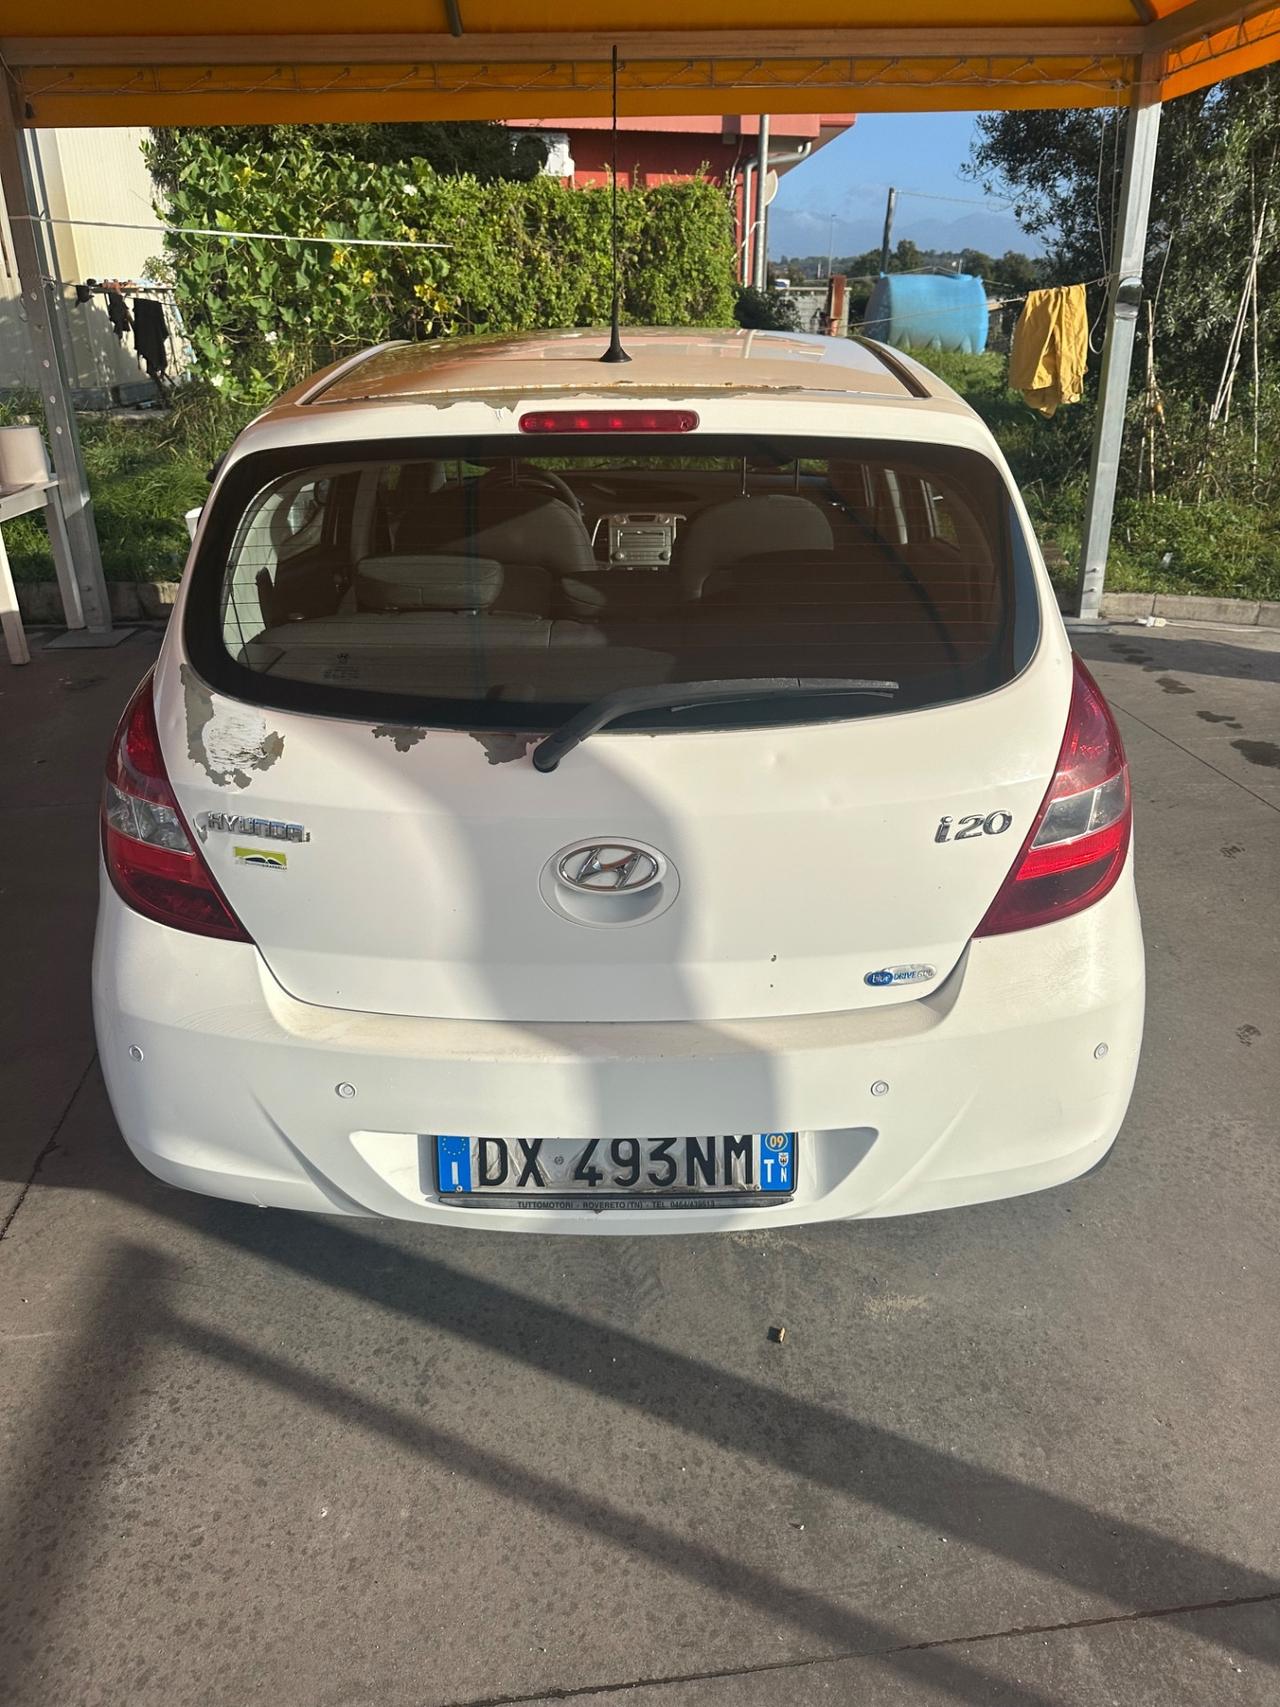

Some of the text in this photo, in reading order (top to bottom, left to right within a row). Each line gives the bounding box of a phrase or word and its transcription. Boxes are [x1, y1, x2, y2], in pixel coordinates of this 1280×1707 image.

[934, 810, 1013, 844] i20
[893, 971, 917, 981] DRIVE
[770, 1135, 784, 1148] 09
[478, 1134, 753, 1188] DX 493NM
